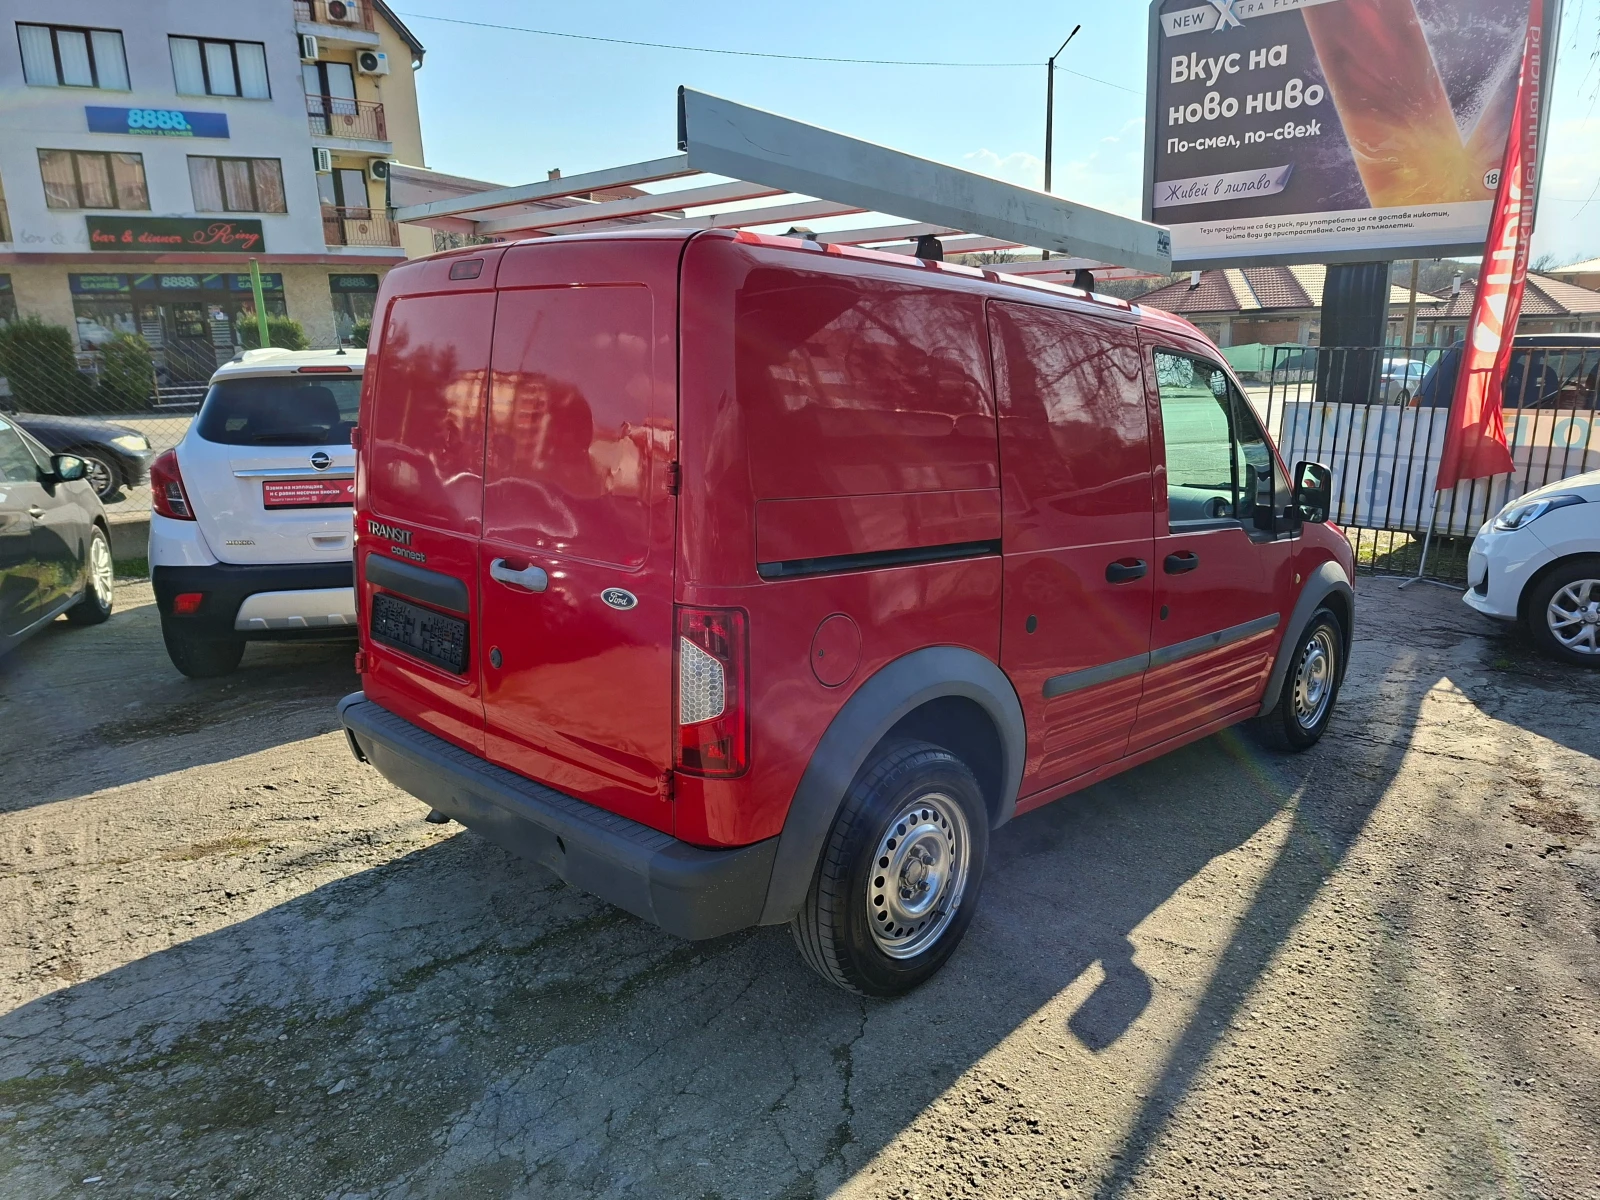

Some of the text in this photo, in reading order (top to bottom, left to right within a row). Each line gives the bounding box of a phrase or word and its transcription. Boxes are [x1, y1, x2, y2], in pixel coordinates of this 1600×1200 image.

[1172, 12, 1205, 29] NEW
[1170, 44, 1288, 87] Вкус на
[1168, 78, 1324, 126] ново ниво
[1167, 119, 1322, 154] По-смел, по-свеж
[1164, 182, 1208, 201] Живей
[1213, 179, 1224, 195] в
[1214, 226, 1246, 234] продукти
[1378, 212, 1412, 222] доставя
[92, 229, 116, 243] bar
[122, 230, 133, 243] &
[138, 232, 182, 244] dinner
[188, 222, 259, 249] Ring
[1247, 232, 1262, 240] води
[367, 519, 412, 546] TRANSIT
[391, 545, 426, 562] connect
[608, 592, 628, 606] Ford
